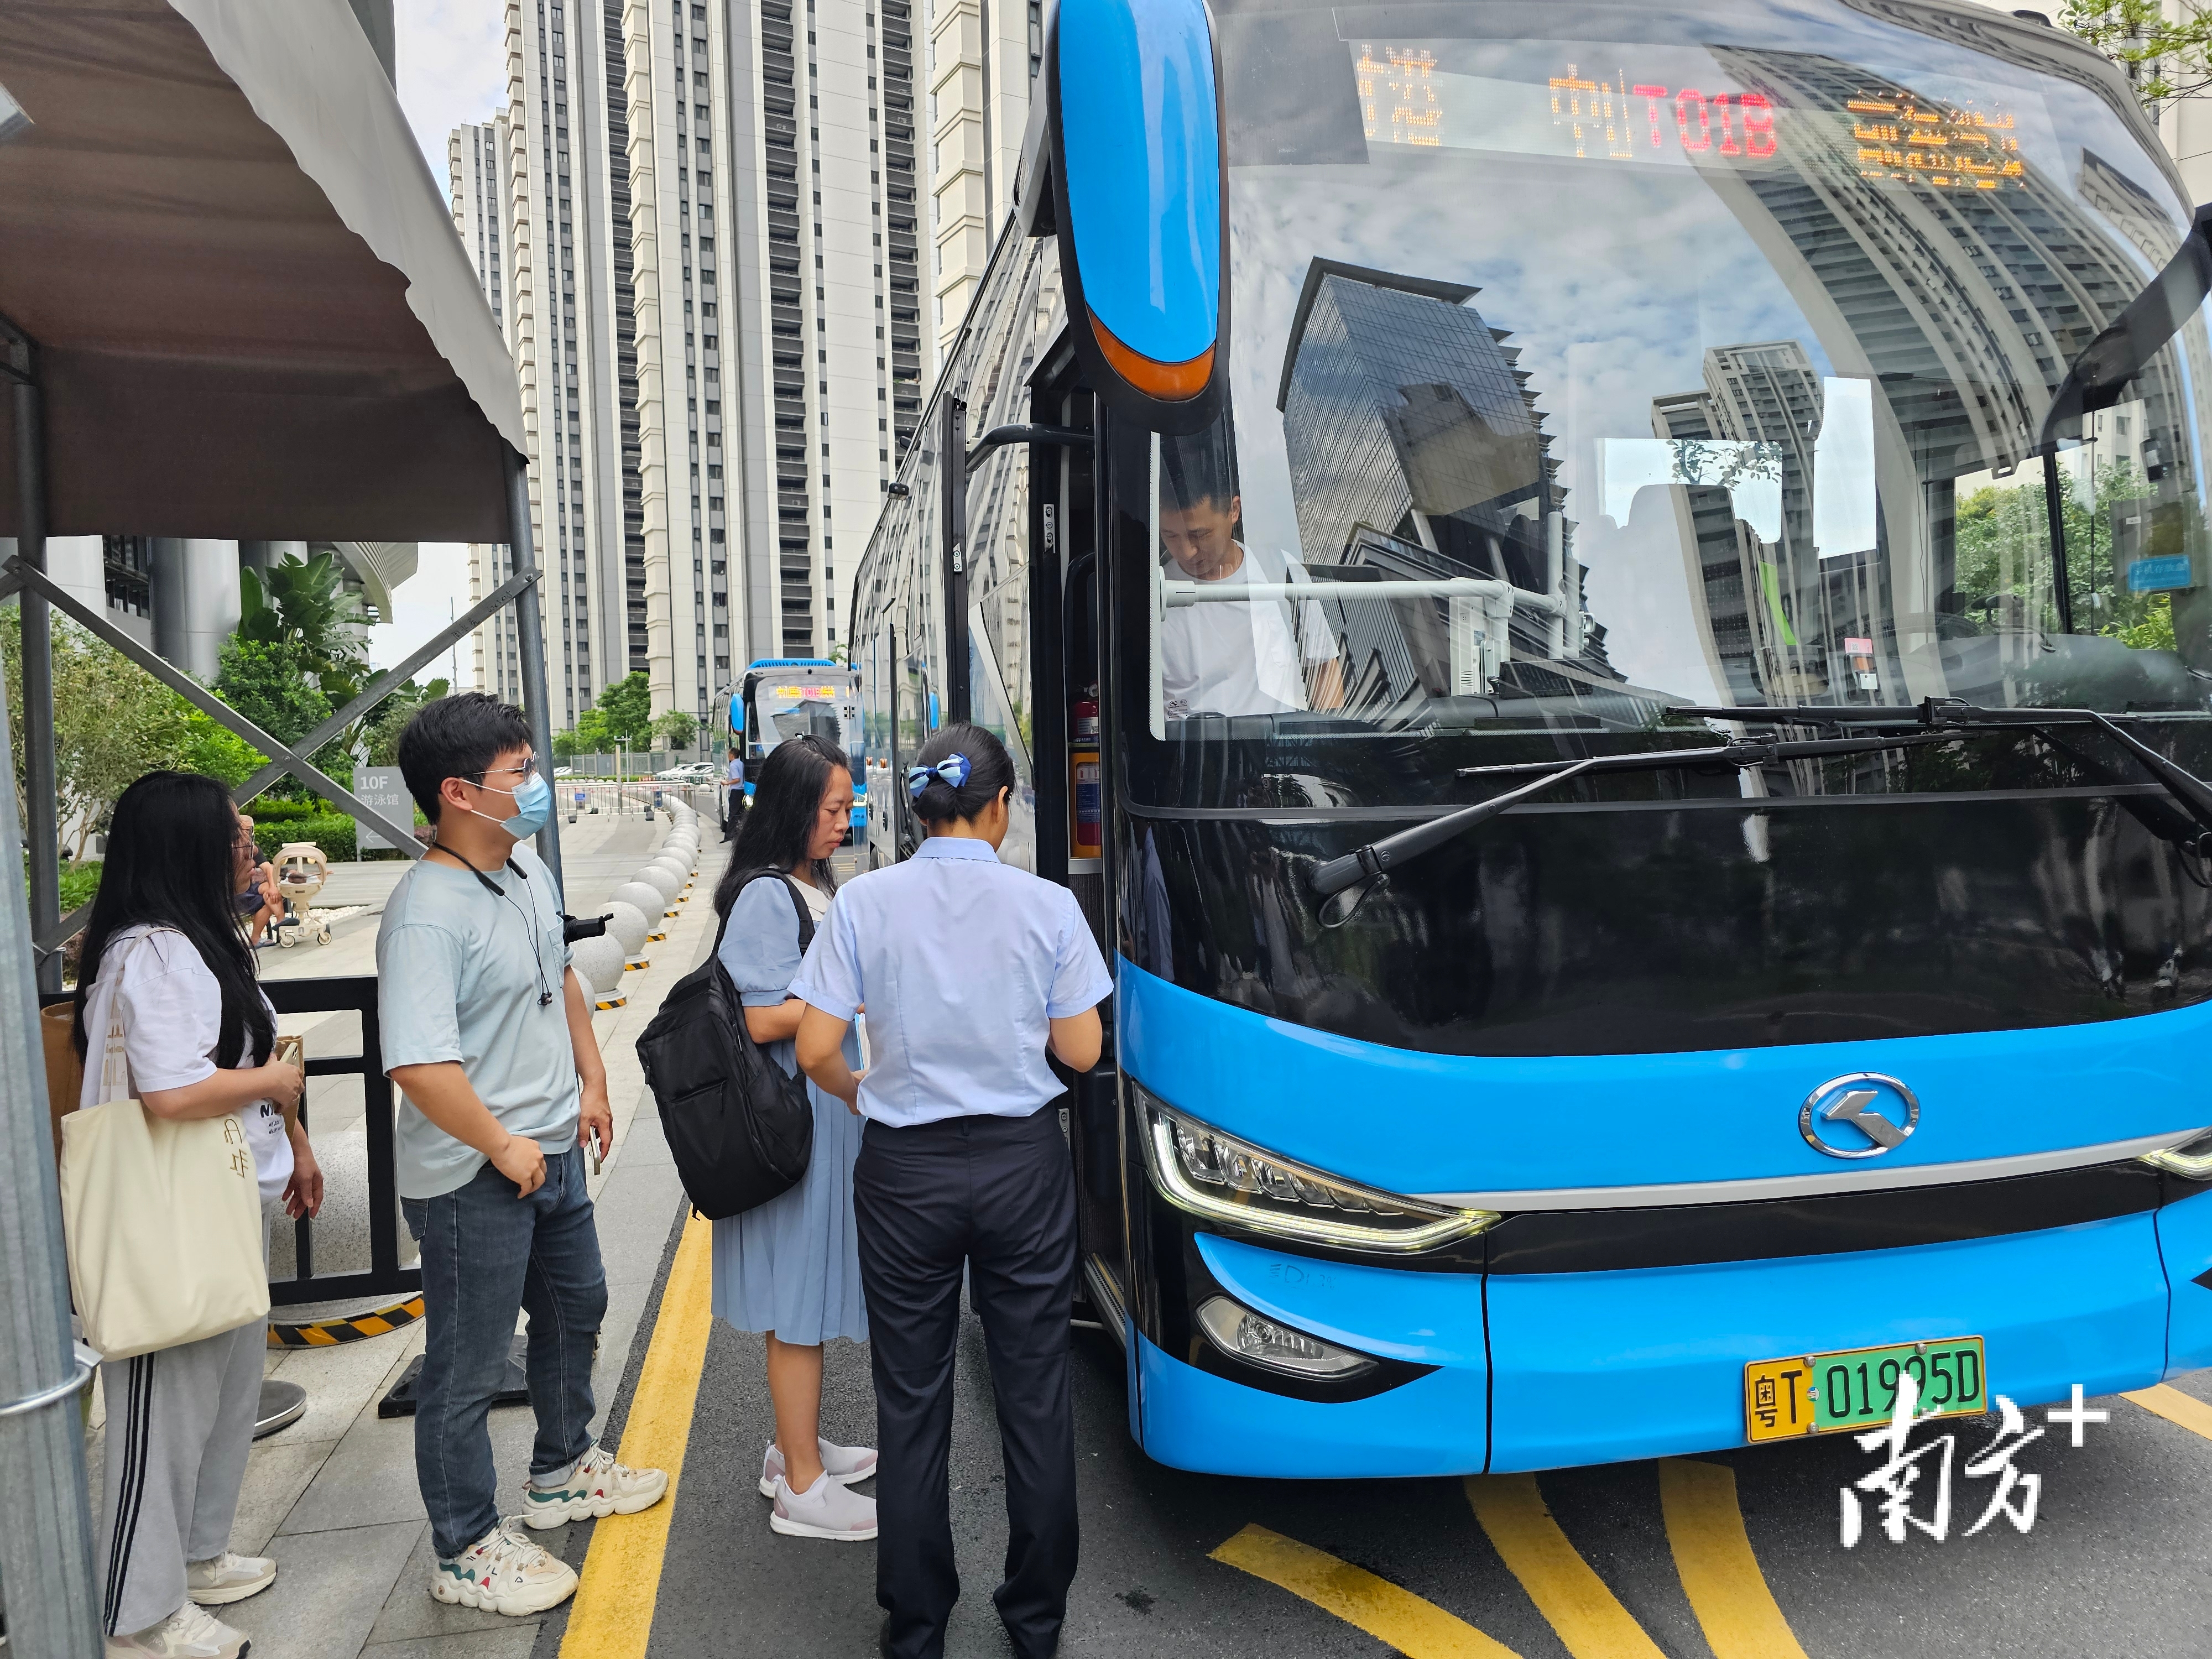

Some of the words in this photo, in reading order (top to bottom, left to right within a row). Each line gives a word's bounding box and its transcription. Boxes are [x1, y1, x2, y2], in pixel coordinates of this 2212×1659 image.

[1633, 84, 1777, 158] T01B
[360, 776, 388, 790] 10F
[360, 793, 399, 806] 游泳馆
[1755, 1369, 1803, 1428] 粤T
[1826, 1349, 1980, 1419] 01995D
